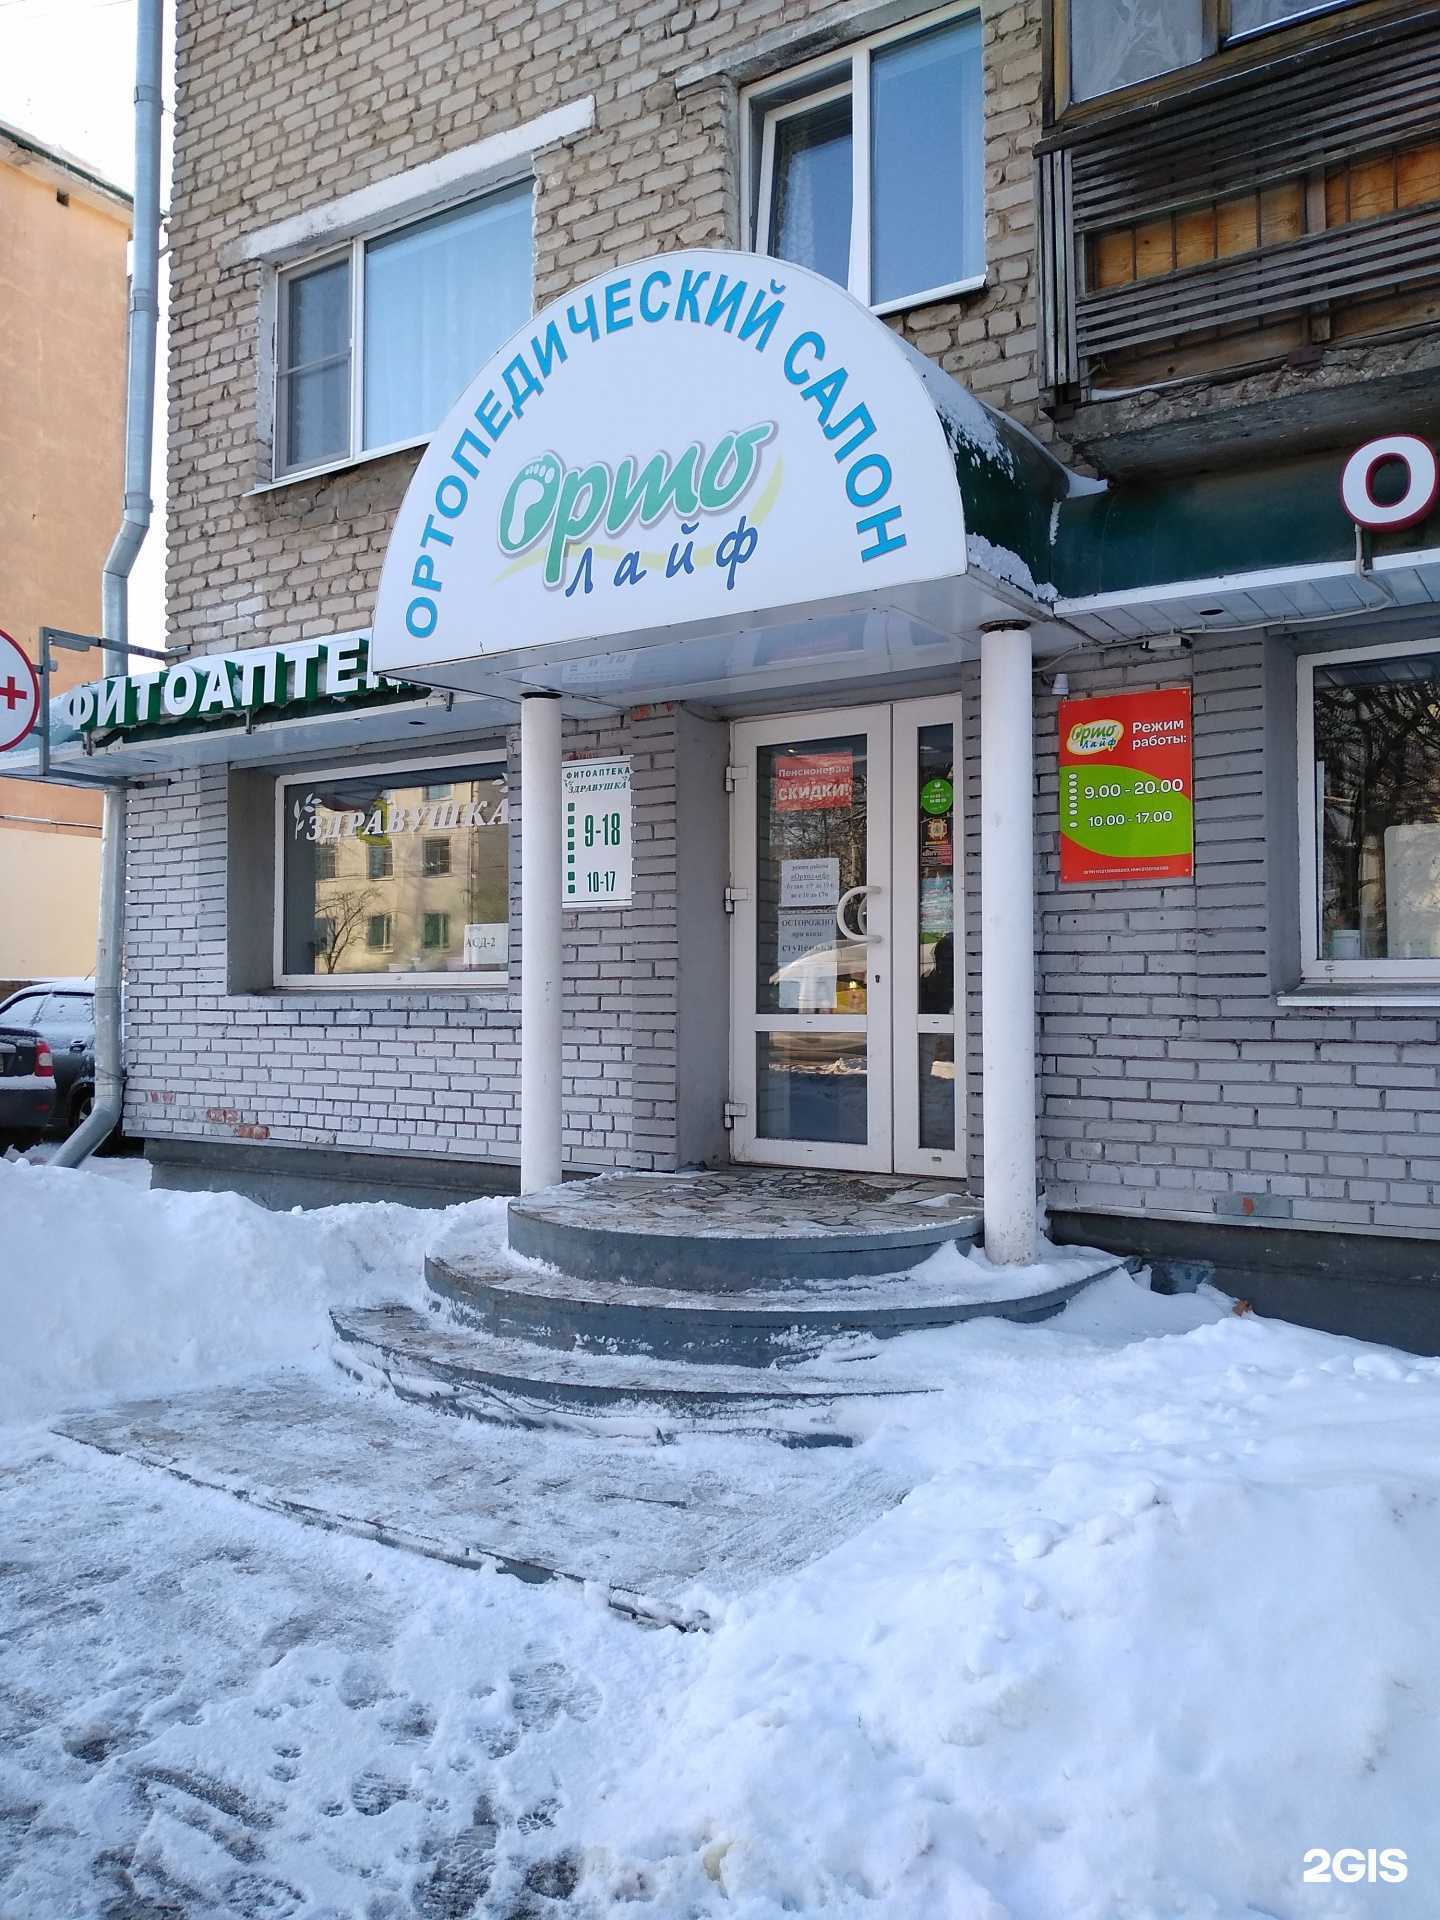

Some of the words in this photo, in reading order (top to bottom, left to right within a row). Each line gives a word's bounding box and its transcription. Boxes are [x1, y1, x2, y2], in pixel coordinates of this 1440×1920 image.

[404, 269, 787, 639] ОРТОПЕДИЧЕСКИЙ
[783, 330, 908, 563] САЛОН
[498, 421, 777, 588] Орто
[1071, 724, 1117, 746] Орто
[1132, 720, 1184, 734] Режим
[1132, 734, 1188, 750] работы:
[566, 766, 631, 779] ФИТОАПТЕКА
[778, 766, 850, 778] Пенсионерам
[567, 780, 627, 794] ЗДРАВУШКА
[1084, 784, 1121, 800] 9.00
[1134, 778, 1185, 795] 20.00
[305, 798, 509, 841] ЗДРАВУШКА
[584, 812, 622, 848] 9-18
[1087, 813, 1125, 828] 10.00
[1135, 810, 1173, 825] 17.00
[586, 870, 616, 893] 10-17
